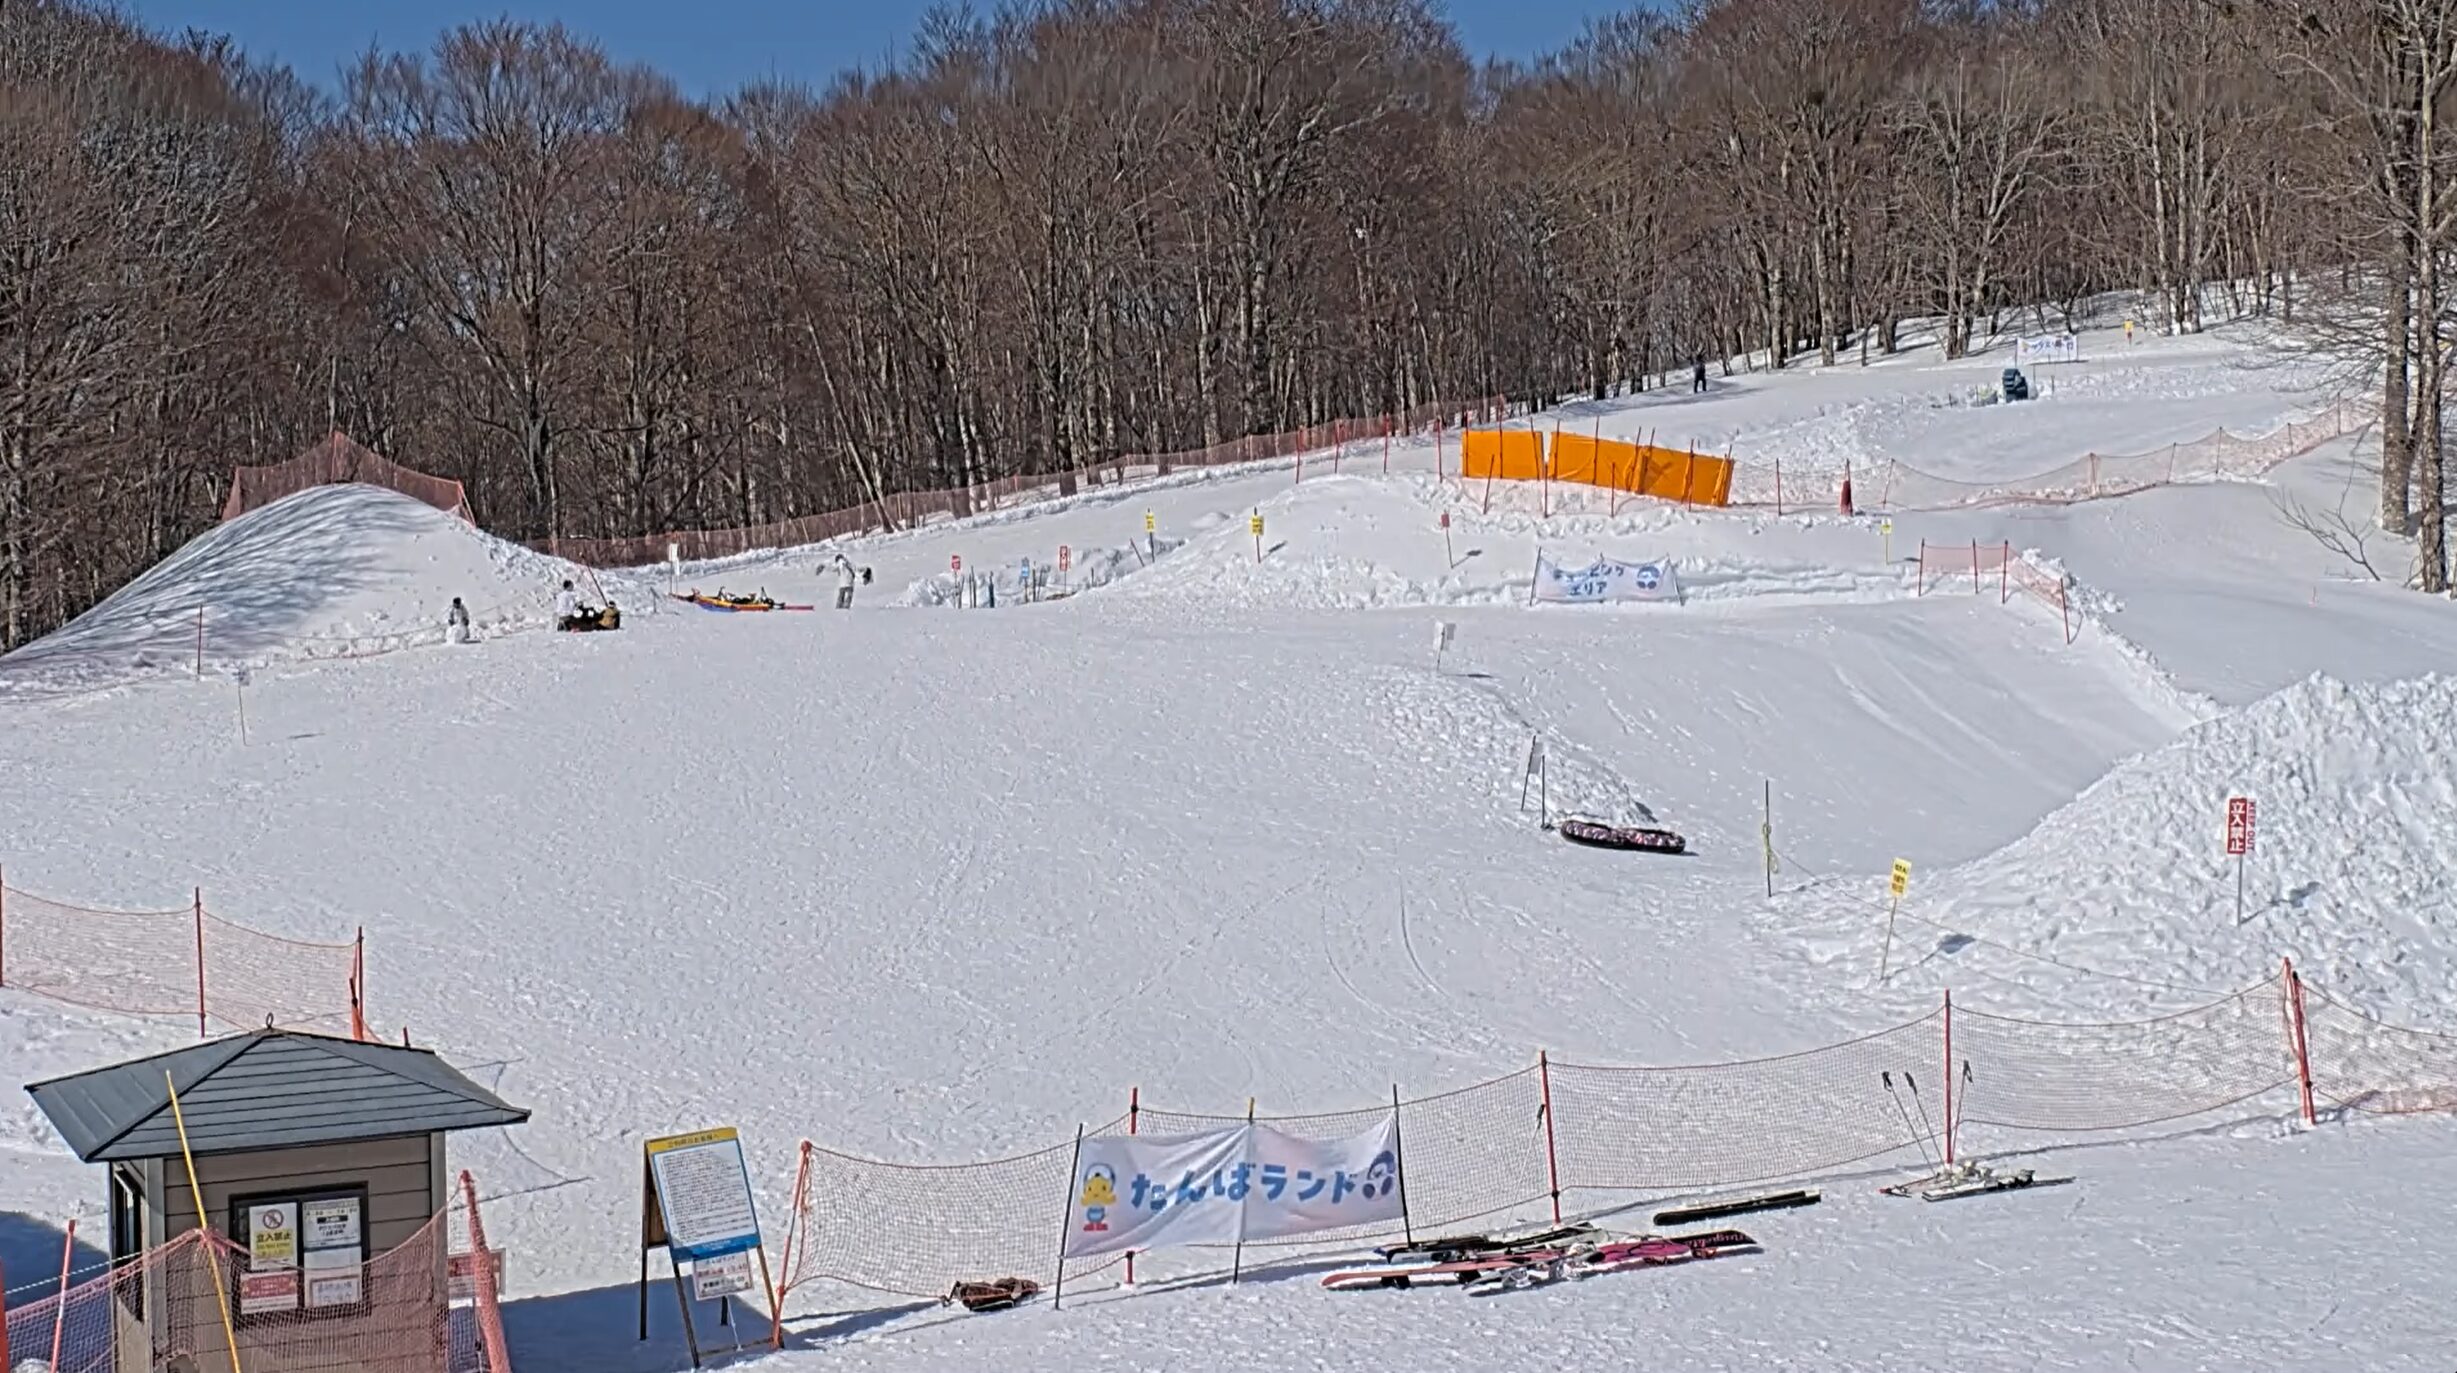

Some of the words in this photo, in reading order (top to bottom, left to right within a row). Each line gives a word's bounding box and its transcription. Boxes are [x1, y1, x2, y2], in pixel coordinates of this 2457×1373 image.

[1568, 581, 1607, 596] エリア
[2230, 801, 2246, 852] 立入禁止
[1131, 1162, 1359, 1211] たんばランド
